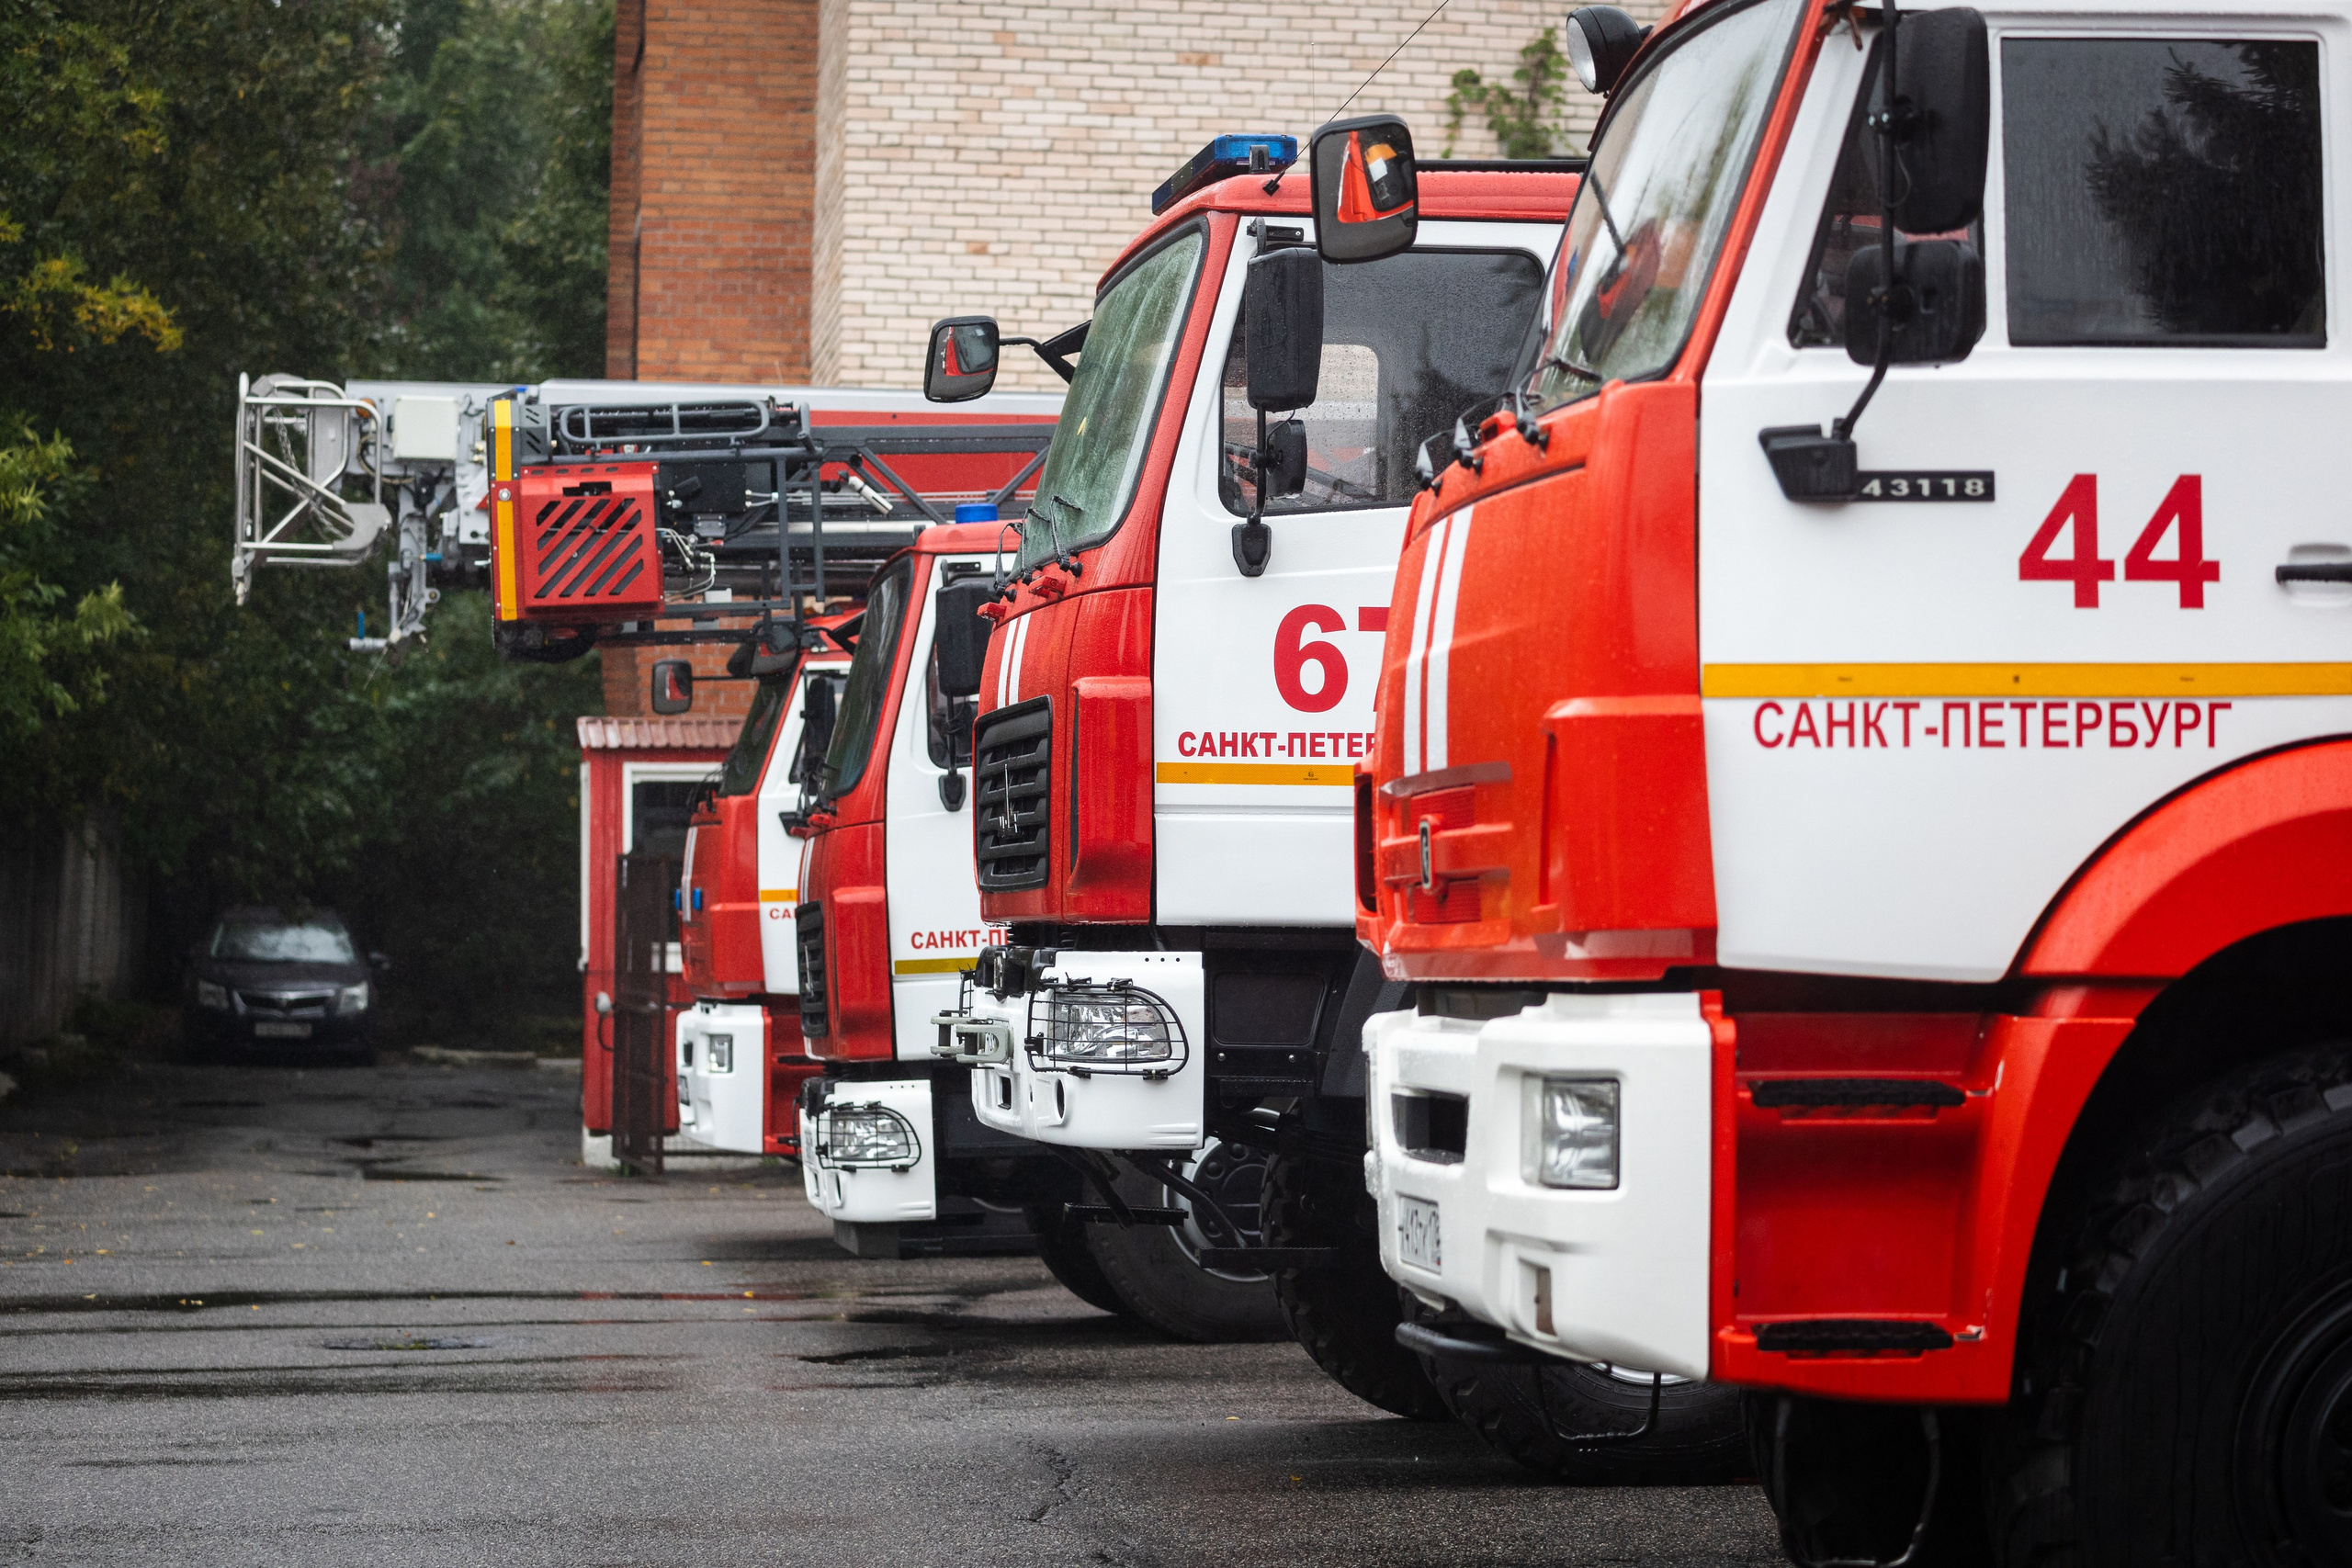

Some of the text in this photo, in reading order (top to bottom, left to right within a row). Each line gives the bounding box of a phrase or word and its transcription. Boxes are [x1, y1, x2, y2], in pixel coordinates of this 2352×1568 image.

[1860, 478, 1985, 498] 43118
[2019, 473, 2221, 609] 44
[1753, 701, 2232, 749] САНКТ-ПЕТЕРБУРГ
[910, 929, 1009, 950] САНКТ-П
